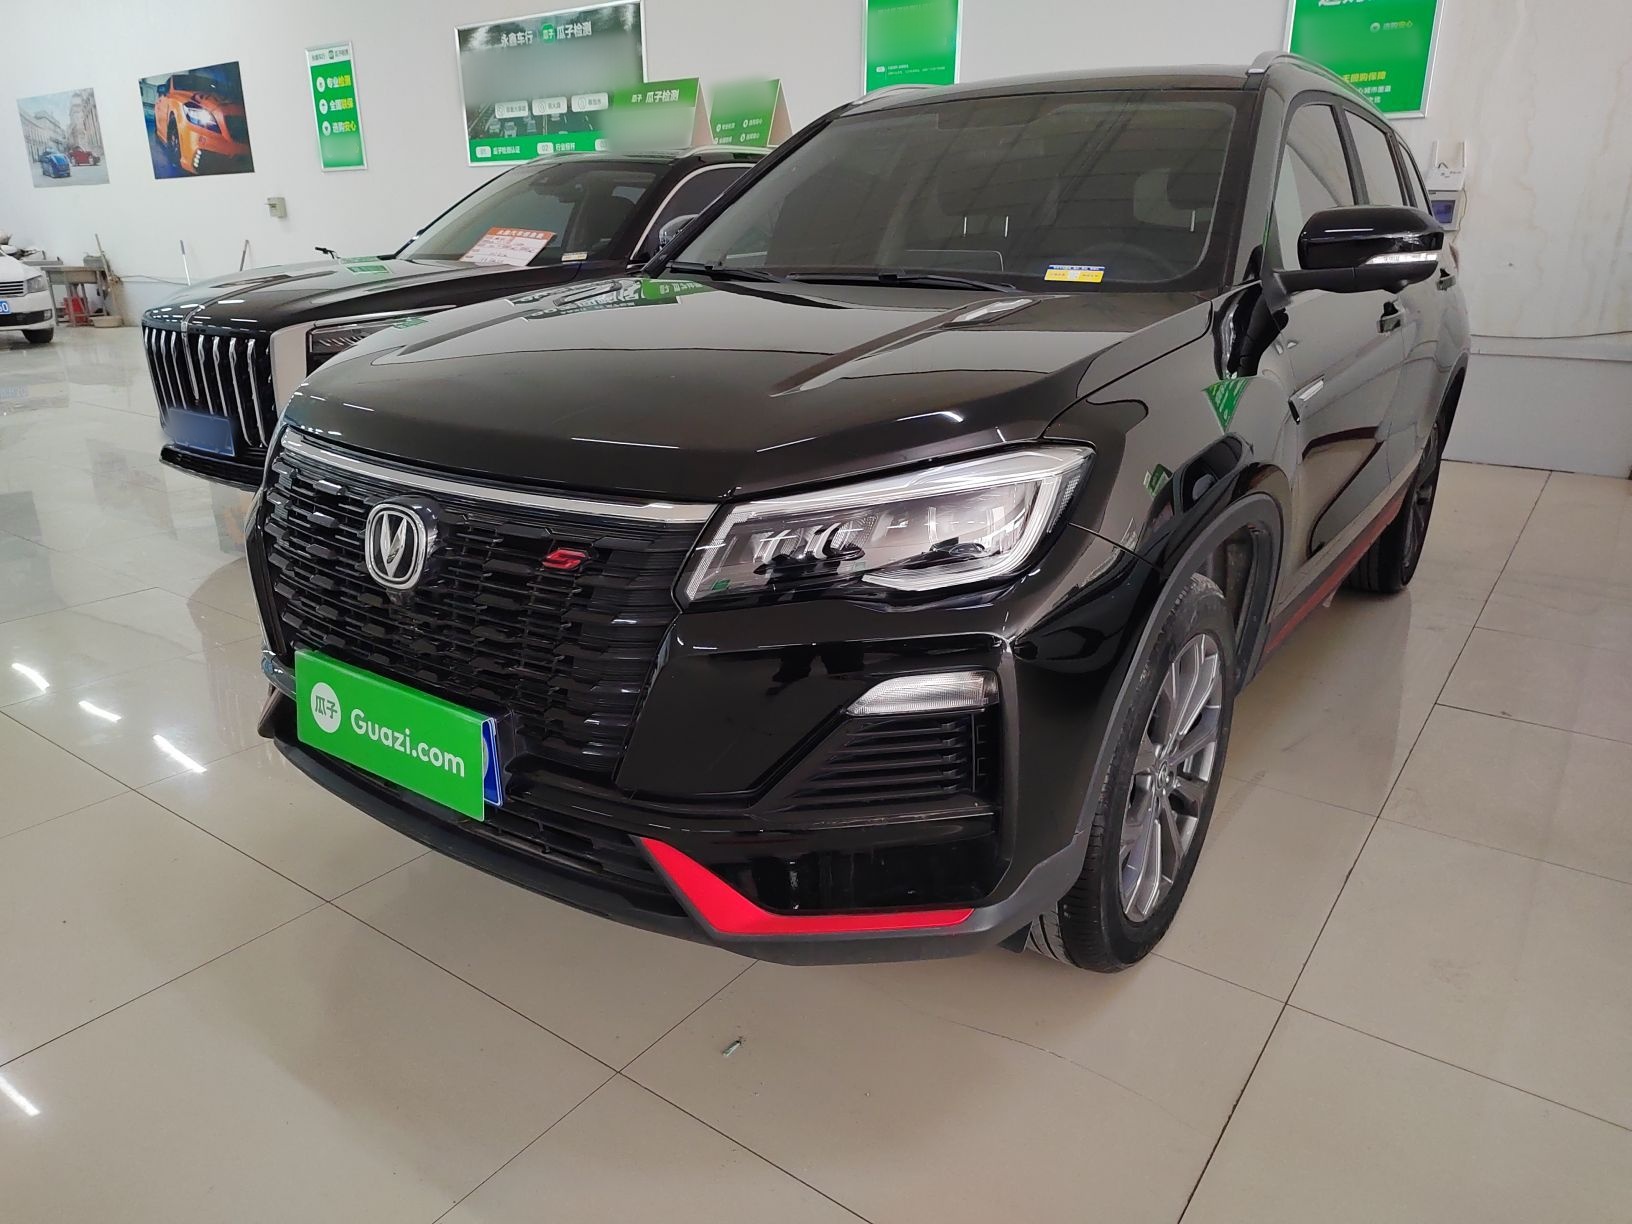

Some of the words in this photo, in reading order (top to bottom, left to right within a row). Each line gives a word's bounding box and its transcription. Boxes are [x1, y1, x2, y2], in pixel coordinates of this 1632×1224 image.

[501, 30, 533, 48] 永鑫车行
[556, 20, 592, 39] 瓜子检测
[645, 89, 680, 104] 瓜子检测
[314, 695, 338, 719] 瓜子
[350, 708, 465, 778] Guazi.com
